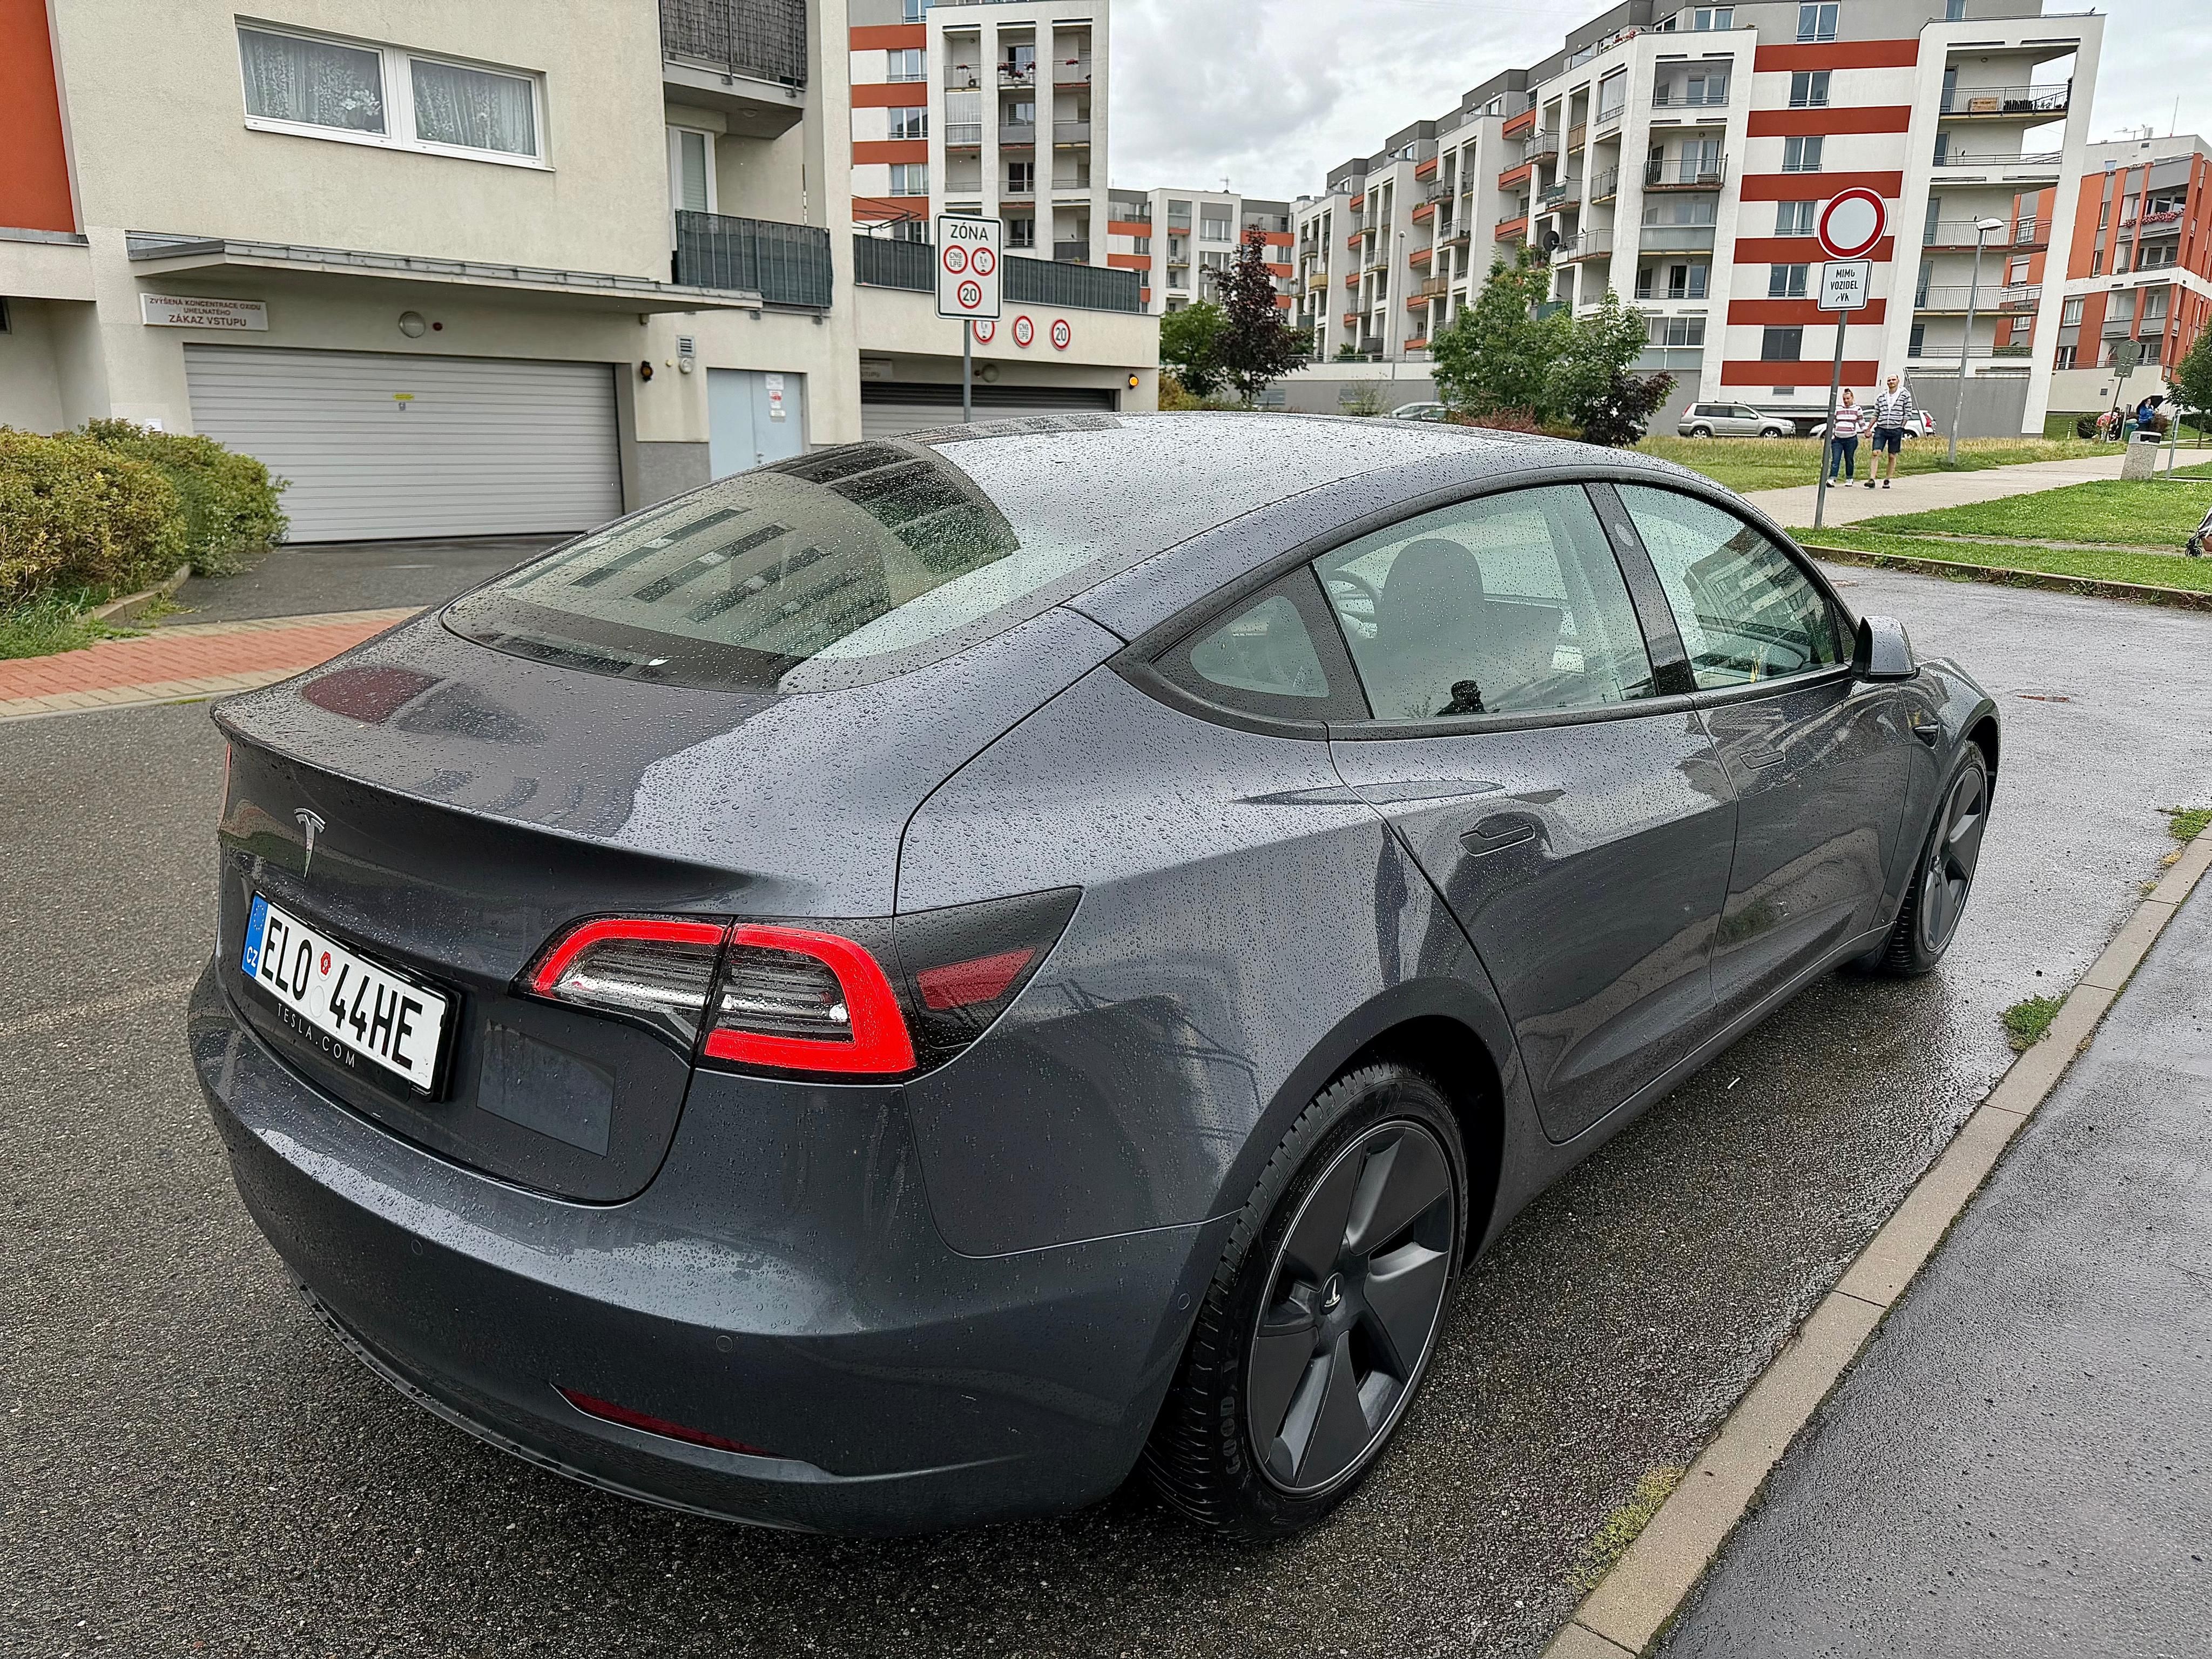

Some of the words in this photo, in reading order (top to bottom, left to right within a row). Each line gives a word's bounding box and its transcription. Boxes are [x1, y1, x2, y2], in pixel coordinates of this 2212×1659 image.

[950, 222, 989, 241] ZÓNA
[1830, 280, 1858, 290] VOZIDEL
[962, 287, 977, 302] 20
[185, 300, 238, 309] KONCENTRACE
[168, 313, 204, 324] ZÁKAZ
[207, 316, 246, 326] VSTUPU
[1056, 327, 1067, 341] 20
[247, 946, 258, 968] CZ
[329, 963, 423, 1071] 44HE
[276, 1002, 355, 1068] TESLA.COM
